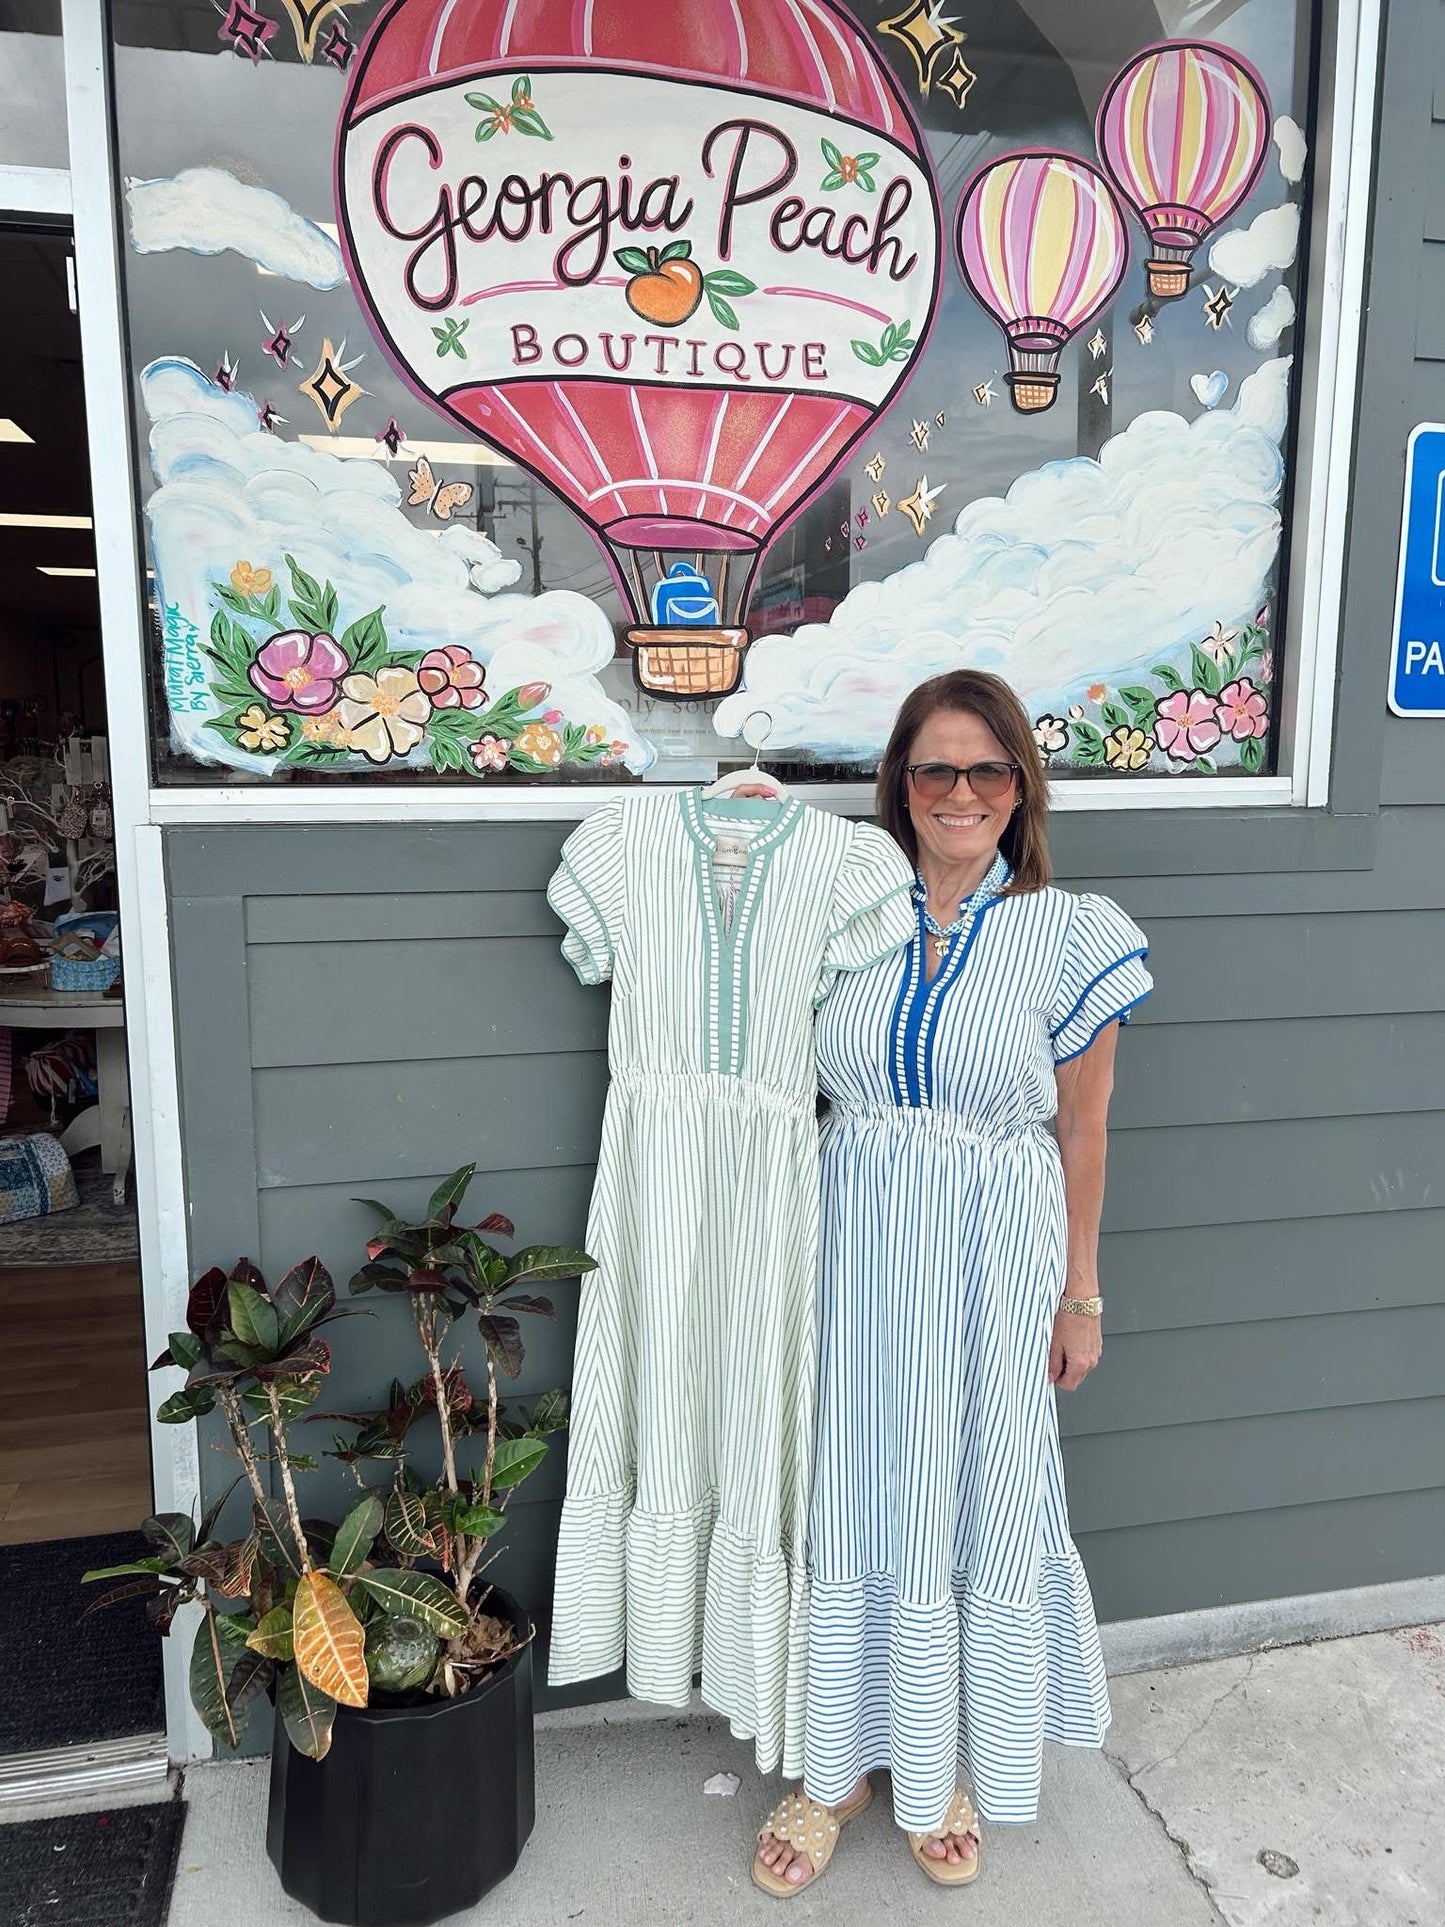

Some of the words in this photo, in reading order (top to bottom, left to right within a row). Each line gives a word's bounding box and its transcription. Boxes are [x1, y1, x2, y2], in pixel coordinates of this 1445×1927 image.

[372, 122, 694, 313] Georgia
[701, 118, 918, 282] Peach
[510, 322, 829, 382] BOUTIQUE
[1405, 641, 1445, 675] PA
